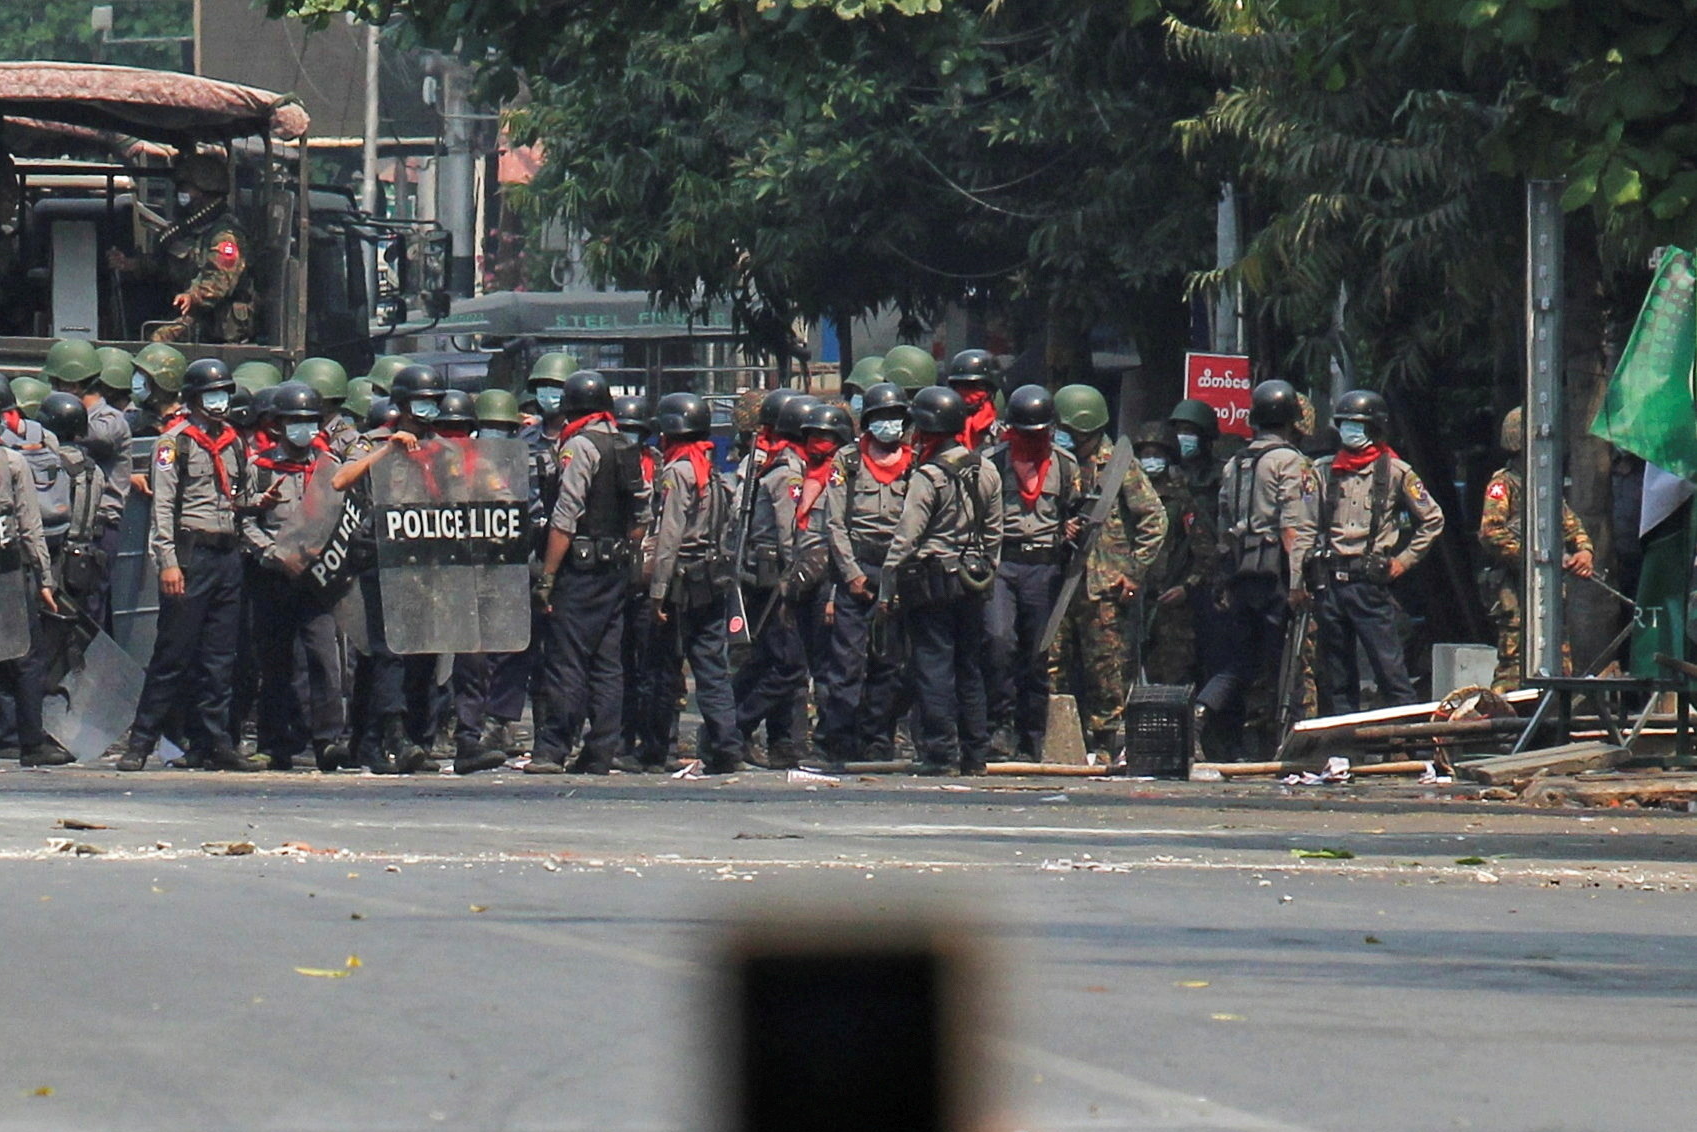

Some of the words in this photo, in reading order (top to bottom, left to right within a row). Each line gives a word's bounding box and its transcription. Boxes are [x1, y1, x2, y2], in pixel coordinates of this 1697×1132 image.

[555, 313, 622, 328] STEEL
[386, 508, 465, 540] POLICE
[311, 498, 362, 587] POLICE
